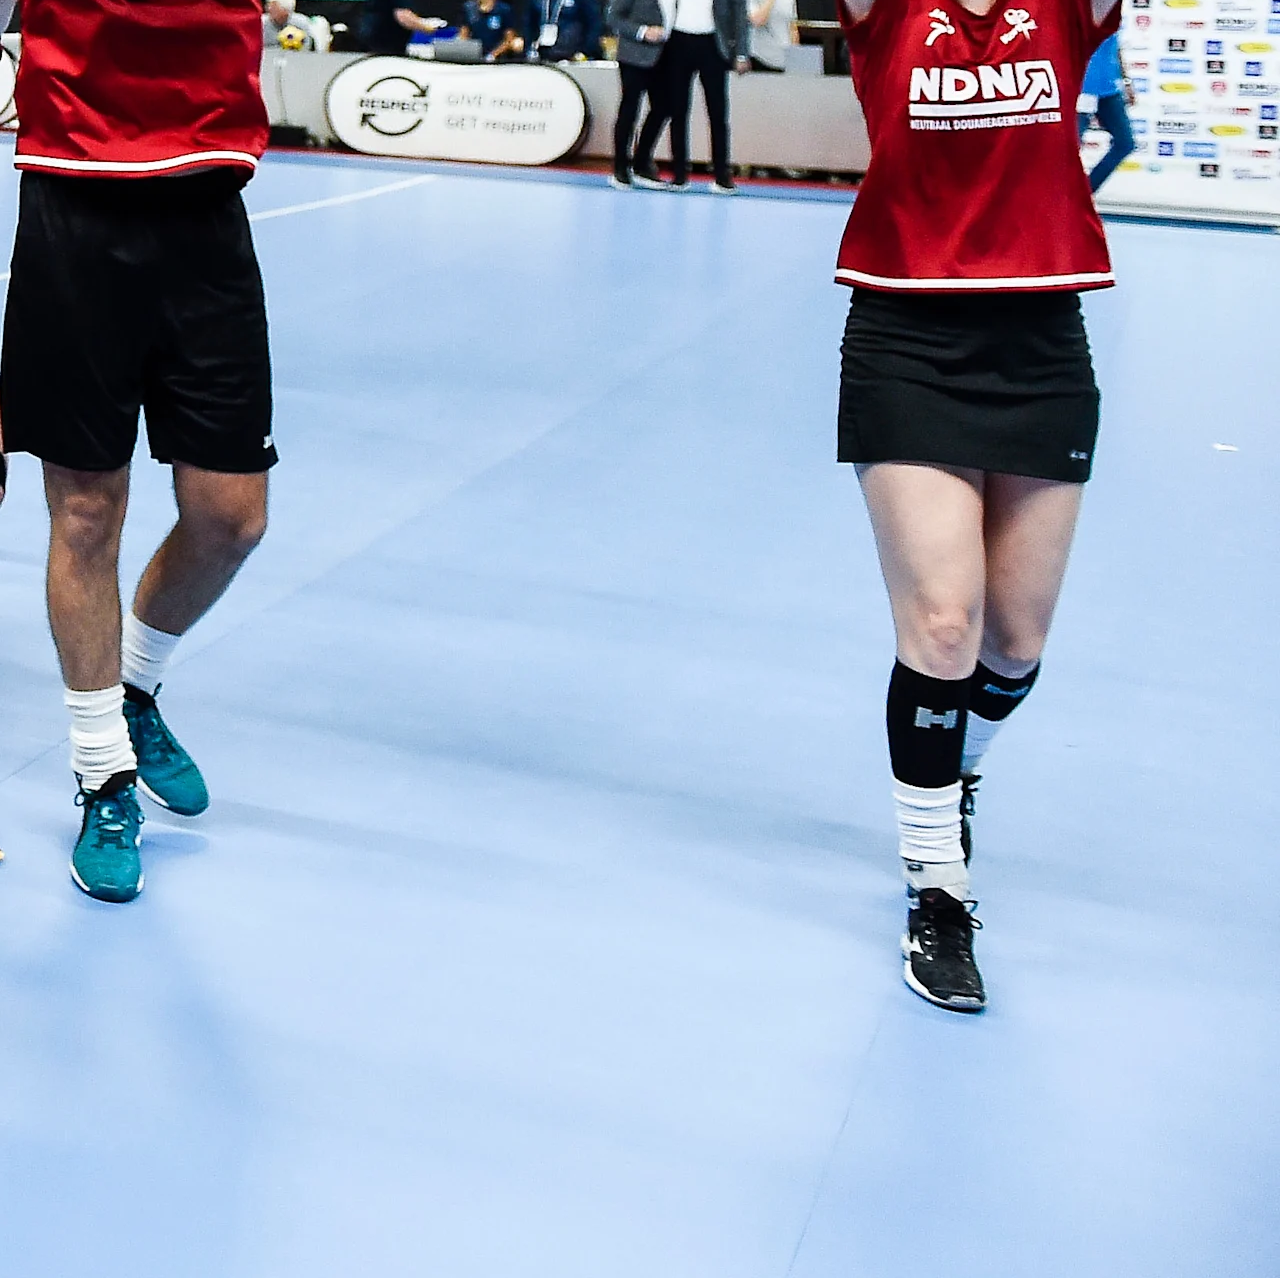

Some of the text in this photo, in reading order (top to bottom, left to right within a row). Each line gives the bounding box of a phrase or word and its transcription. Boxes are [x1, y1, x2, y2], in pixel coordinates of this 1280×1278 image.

[909, 62, 1018, 102] NDN
[360, 97, 428, 113] RESPECT
[448, 93, 554, 112] GIVE respect
[484, 120, 547, 135] respect
